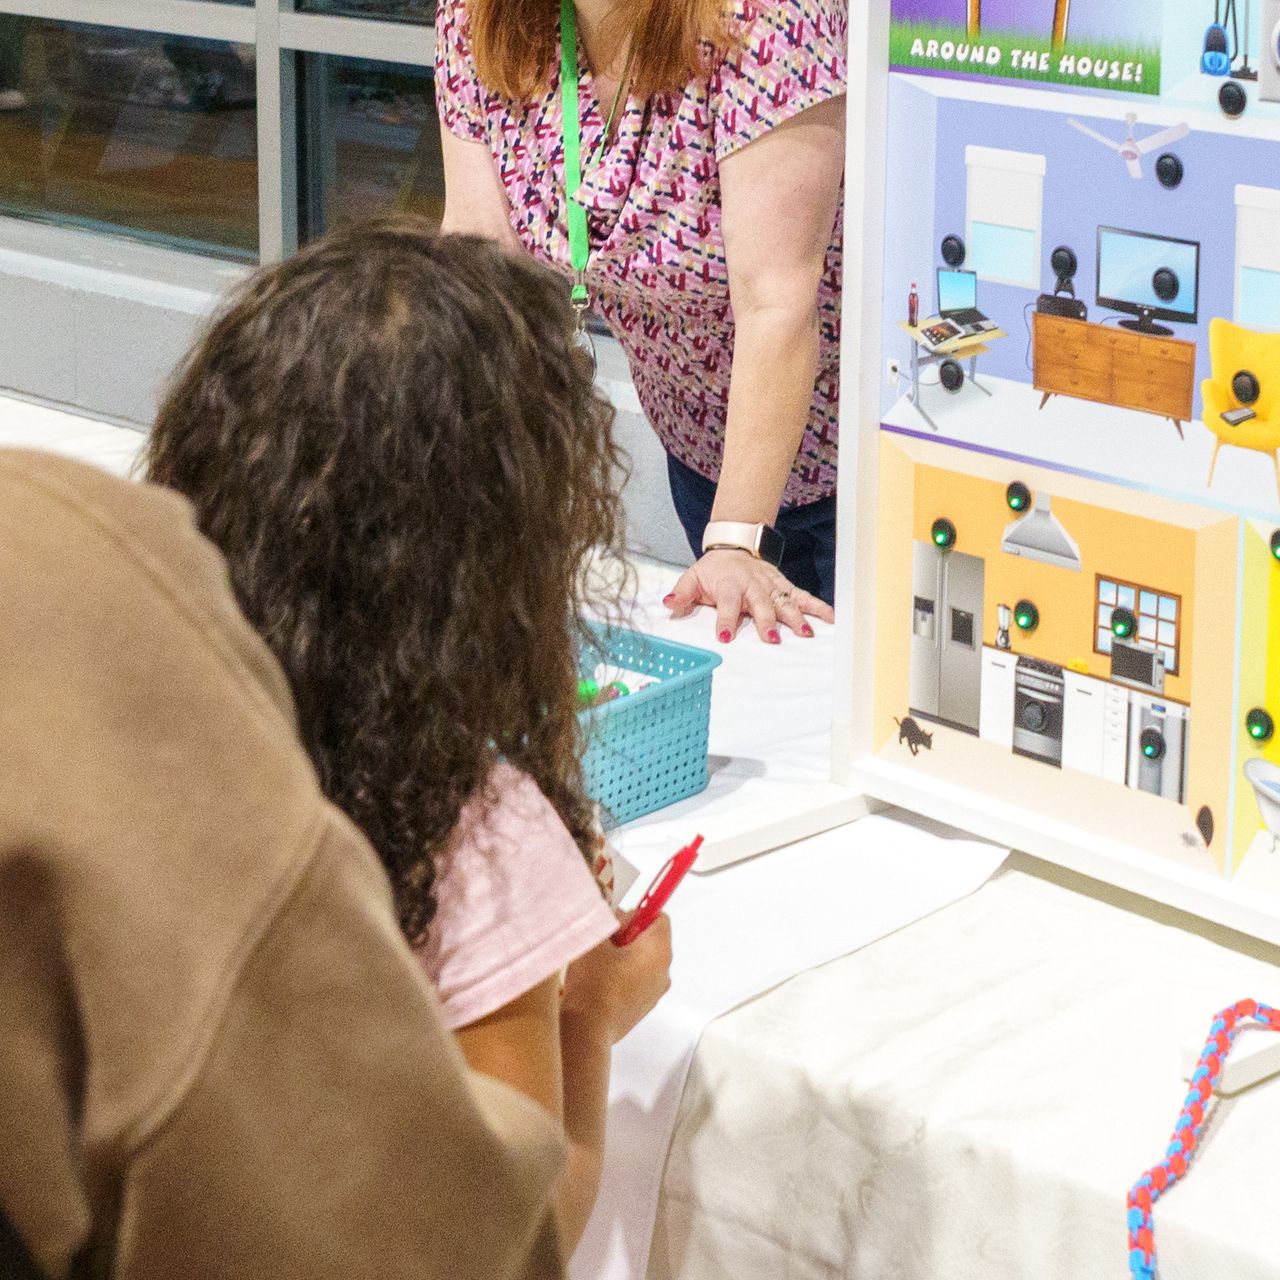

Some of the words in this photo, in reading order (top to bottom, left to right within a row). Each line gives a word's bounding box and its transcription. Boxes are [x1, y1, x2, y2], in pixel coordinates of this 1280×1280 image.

[910, 38, 1002, 66] AROUND
[1011, 49, 1051, 71] THE
[1059, 54, 1144, 83] HOUSE!
